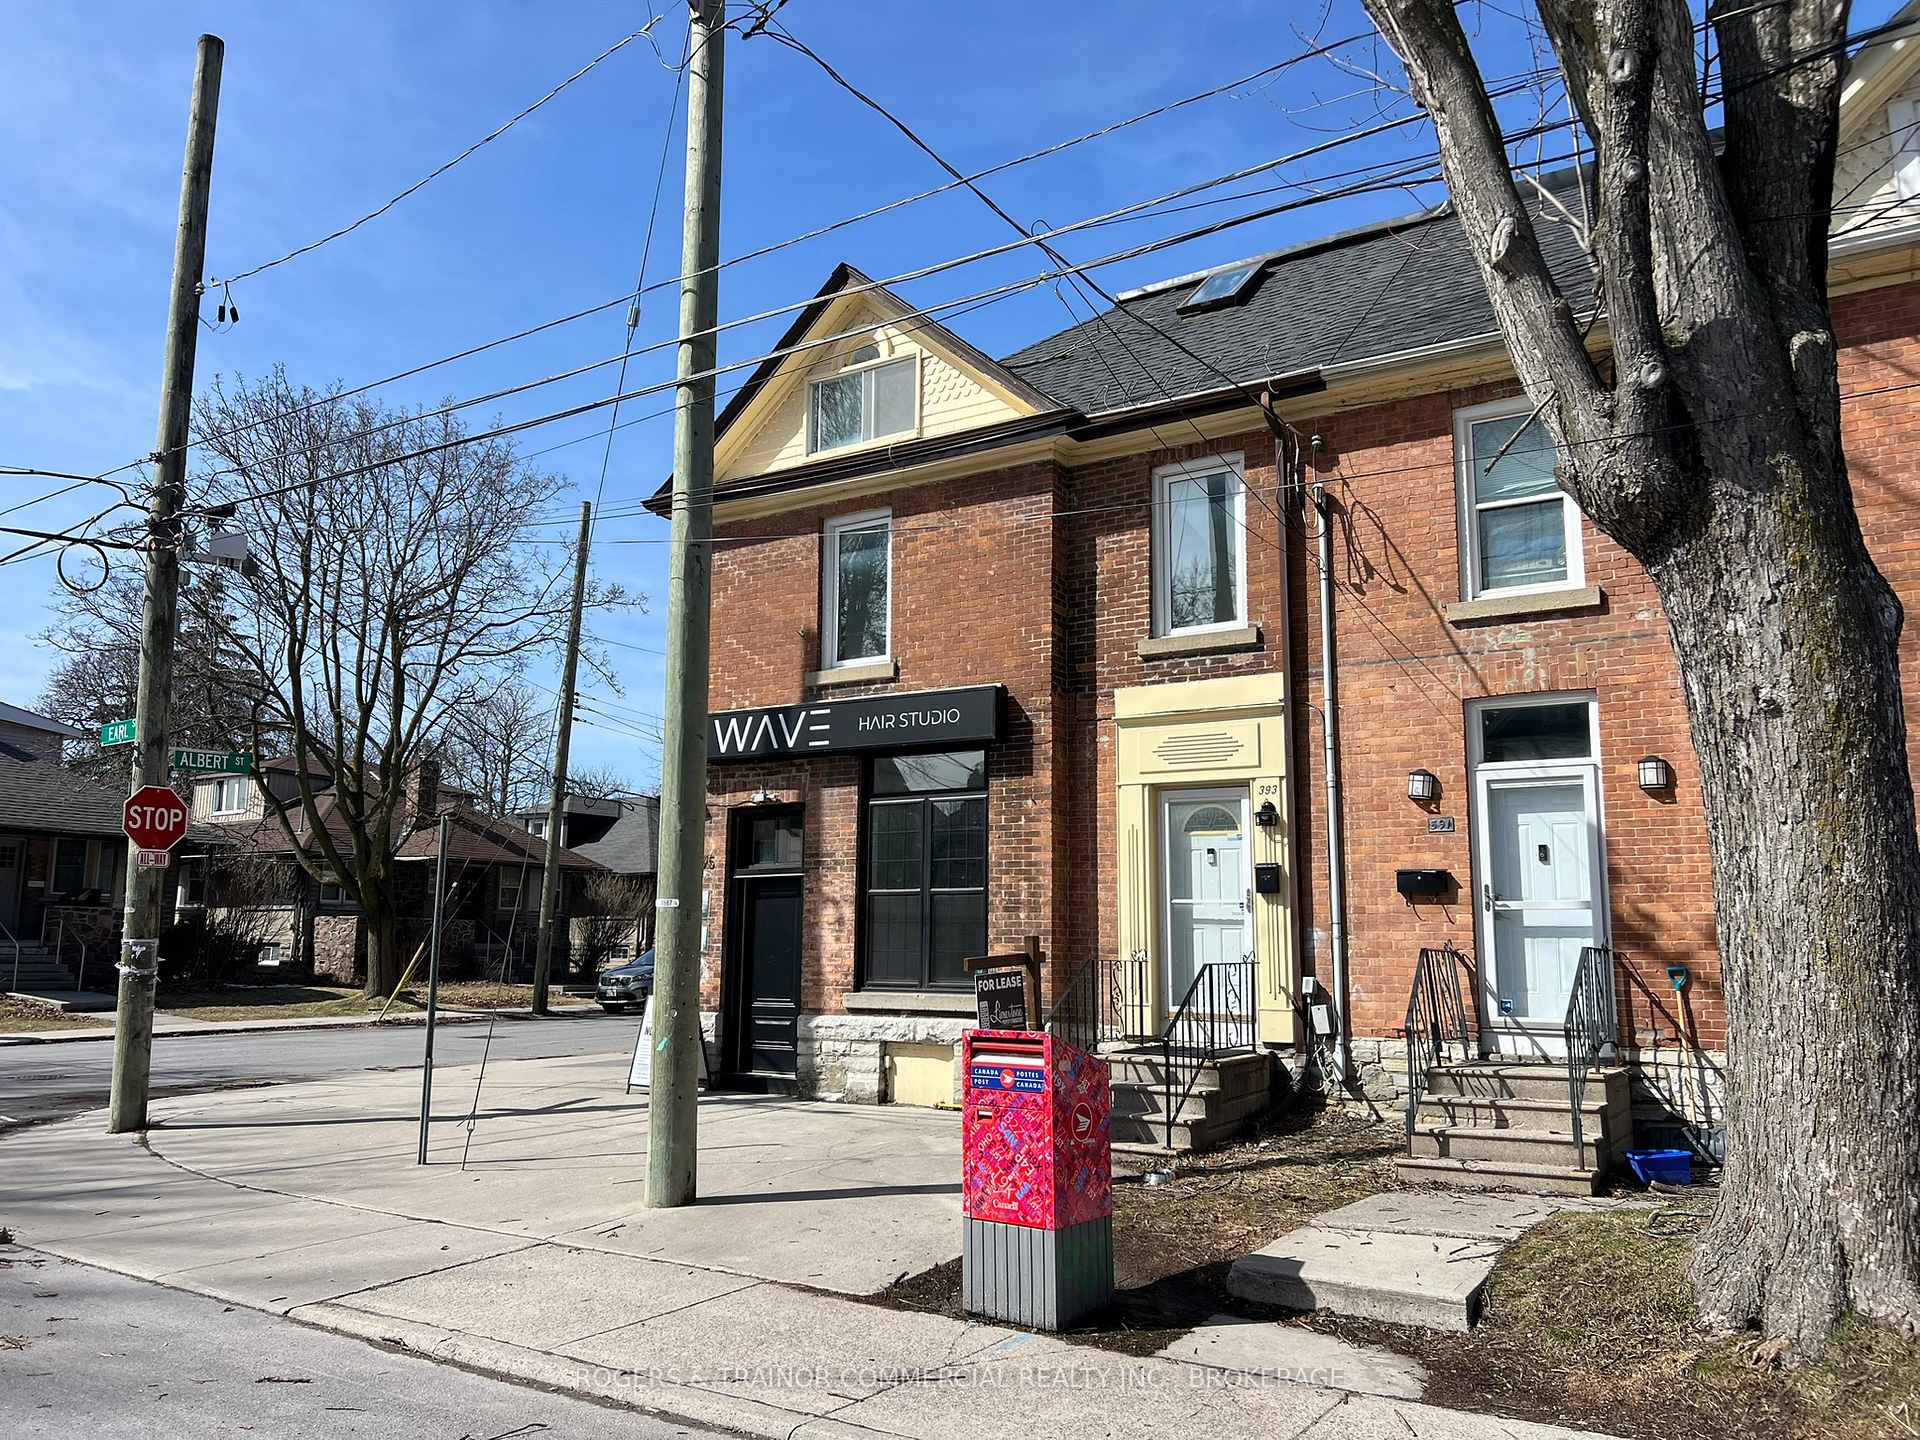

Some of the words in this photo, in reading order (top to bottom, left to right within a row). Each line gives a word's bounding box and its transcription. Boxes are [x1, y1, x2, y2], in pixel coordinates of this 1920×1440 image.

[108, 724, 129, 741] EARL
[714, 709, 831, 753] WAVE
[858, 714, 896, 732] HAIR
[898, 708, 960, 728] STUDIO
[179, 752, 229, 769] ALBERT
[234, 756, 245, 766] ST
[1258, 785, 1278, 795] 393
[128, 805, 183, 831] STOP
[978, 979, 995, 992] FOR
[995, 975, 1022, 990] LEASE
[974, 1068, 998, 1076] CANADA
